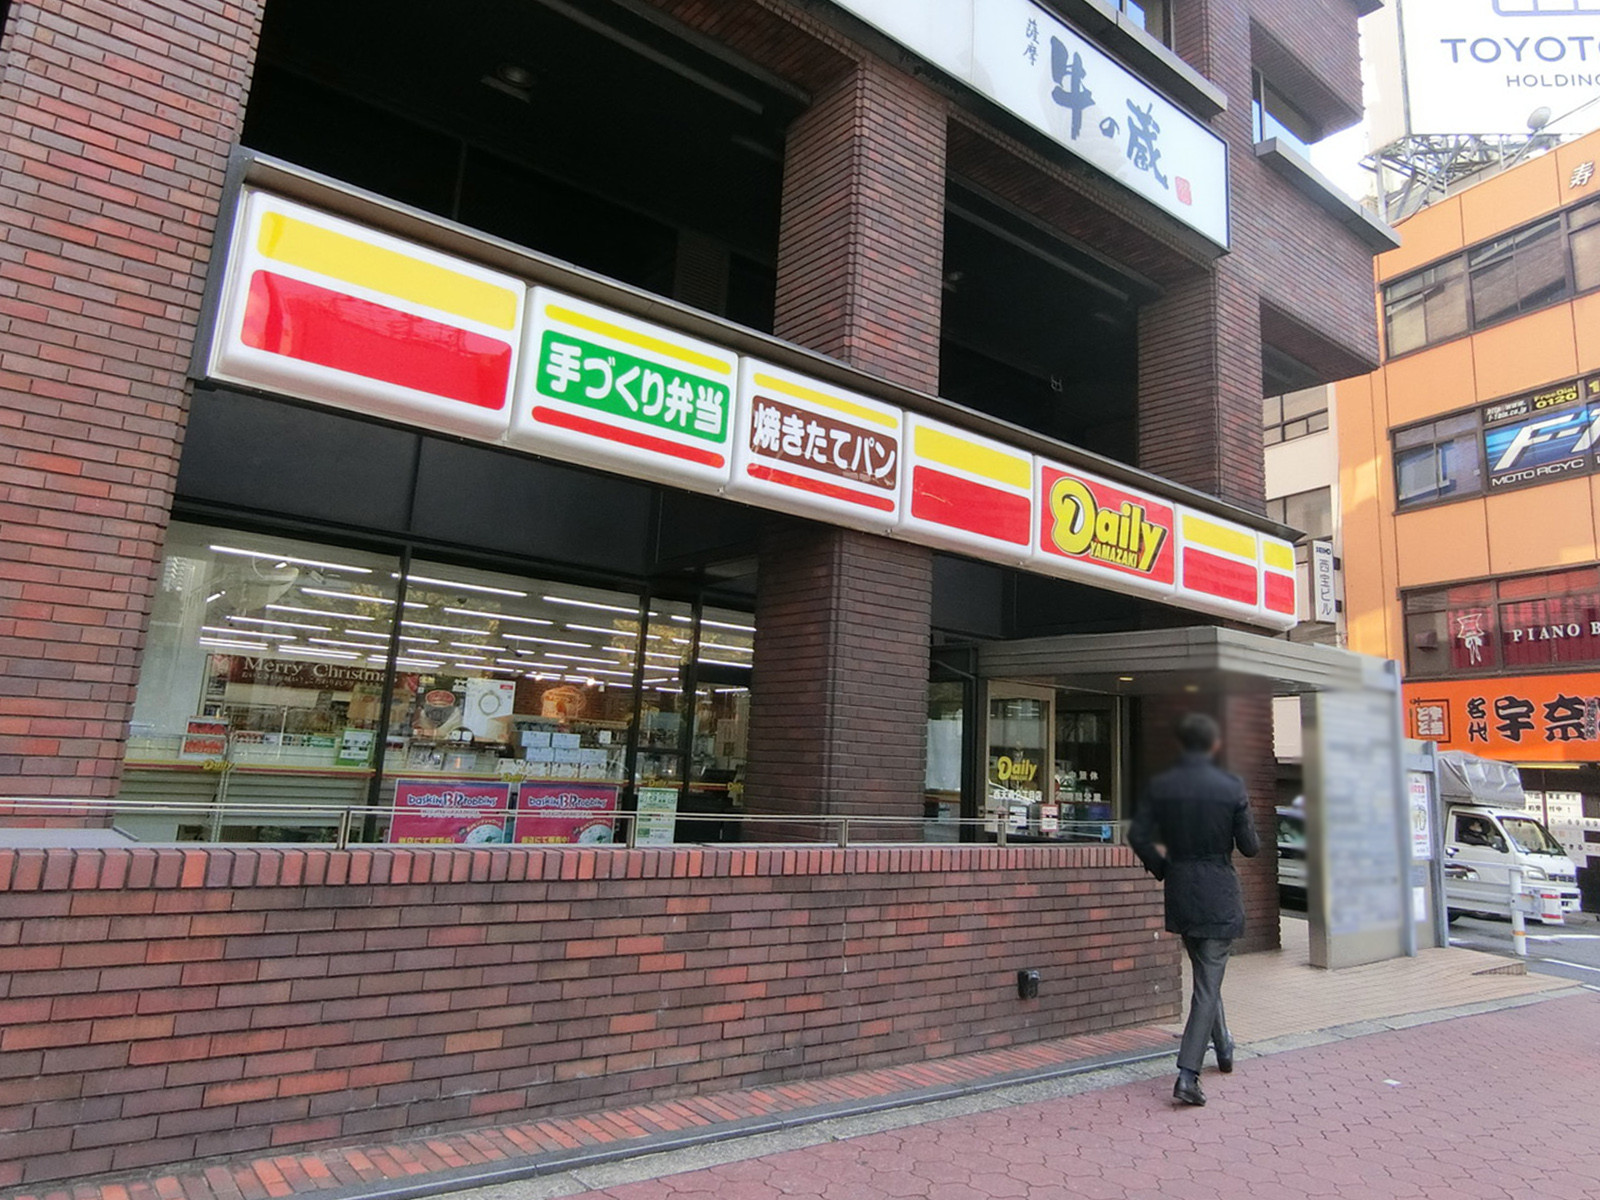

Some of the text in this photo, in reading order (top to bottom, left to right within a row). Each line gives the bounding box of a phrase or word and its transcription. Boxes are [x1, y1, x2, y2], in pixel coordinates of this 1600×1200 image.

[1440, 36, 1600, 63] TOYOT
[1050, 35, 1169, 190] 牛の蔵
[1569, 161, 1595, 188] 寿
[546, 341, 724, 435] 手づくり弁当
[1535, 392, 1577, 409] 0120
[753, 402, 896, 478] 焼きたてパン
[1051, 476, 1167, 573] Daily
[1089, 541, 1139, 568] YAMAZAKI
[1512, 623, 1581, 643] PIANO
[243, 656, 302, 679] Merry
[1494, 693, 1600, 743] 宇奈
[998, 756, 1037, 780] Daily
